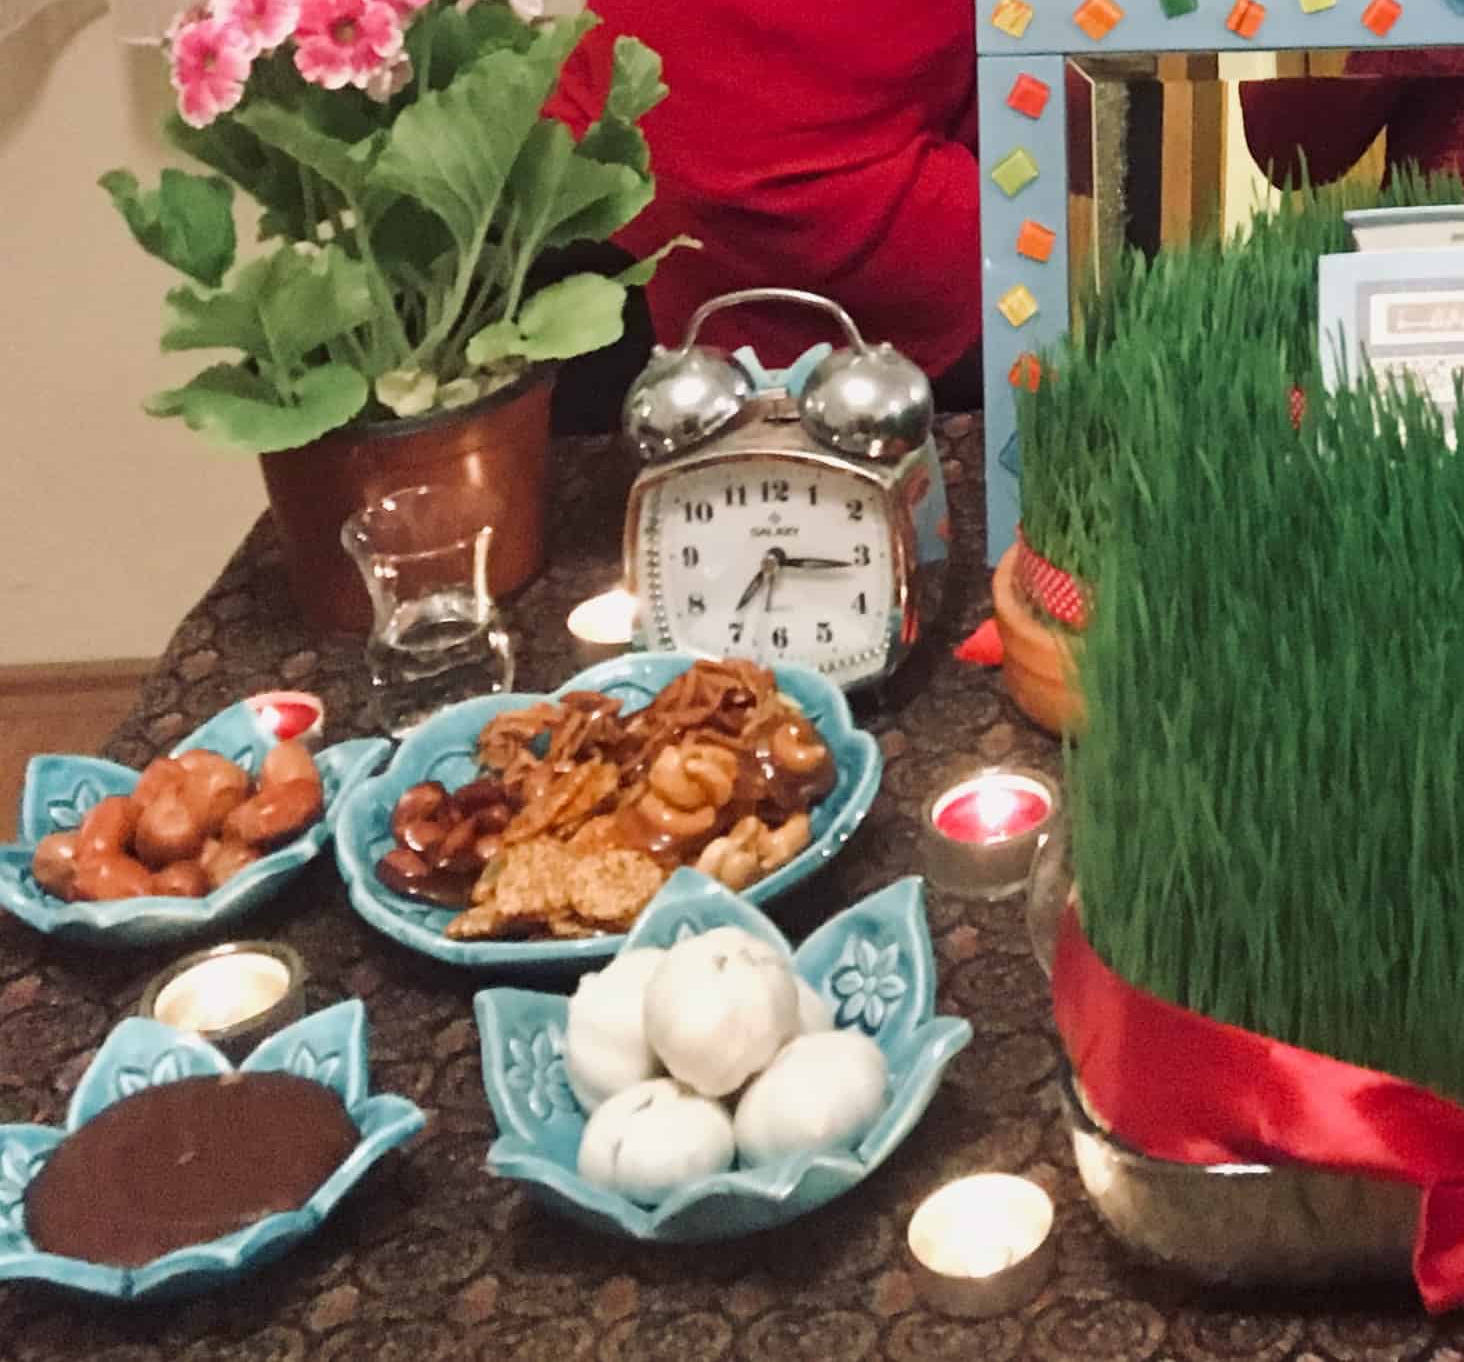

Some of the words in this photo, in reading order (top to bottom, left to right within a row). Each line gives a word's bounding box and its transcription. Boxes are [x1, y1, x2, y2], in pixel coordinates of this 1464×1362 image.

[725, 485, 746, 506] 11
[763, 480, 788, 502] 12
[808, 485, 817, 506] 1
[685, 502, 713, 523] 10
[846, 500, 862, 521] 2
[682, 546, 699, 567] 9
[853, 544, 870, 566] 3
[688, 594, 705, 614] 8
[852, 593, 867, 614] 4
[729, 622, 743, 643] 7
[772, 627, 788, 648] 6
[816, 622, 832, 643] 5
